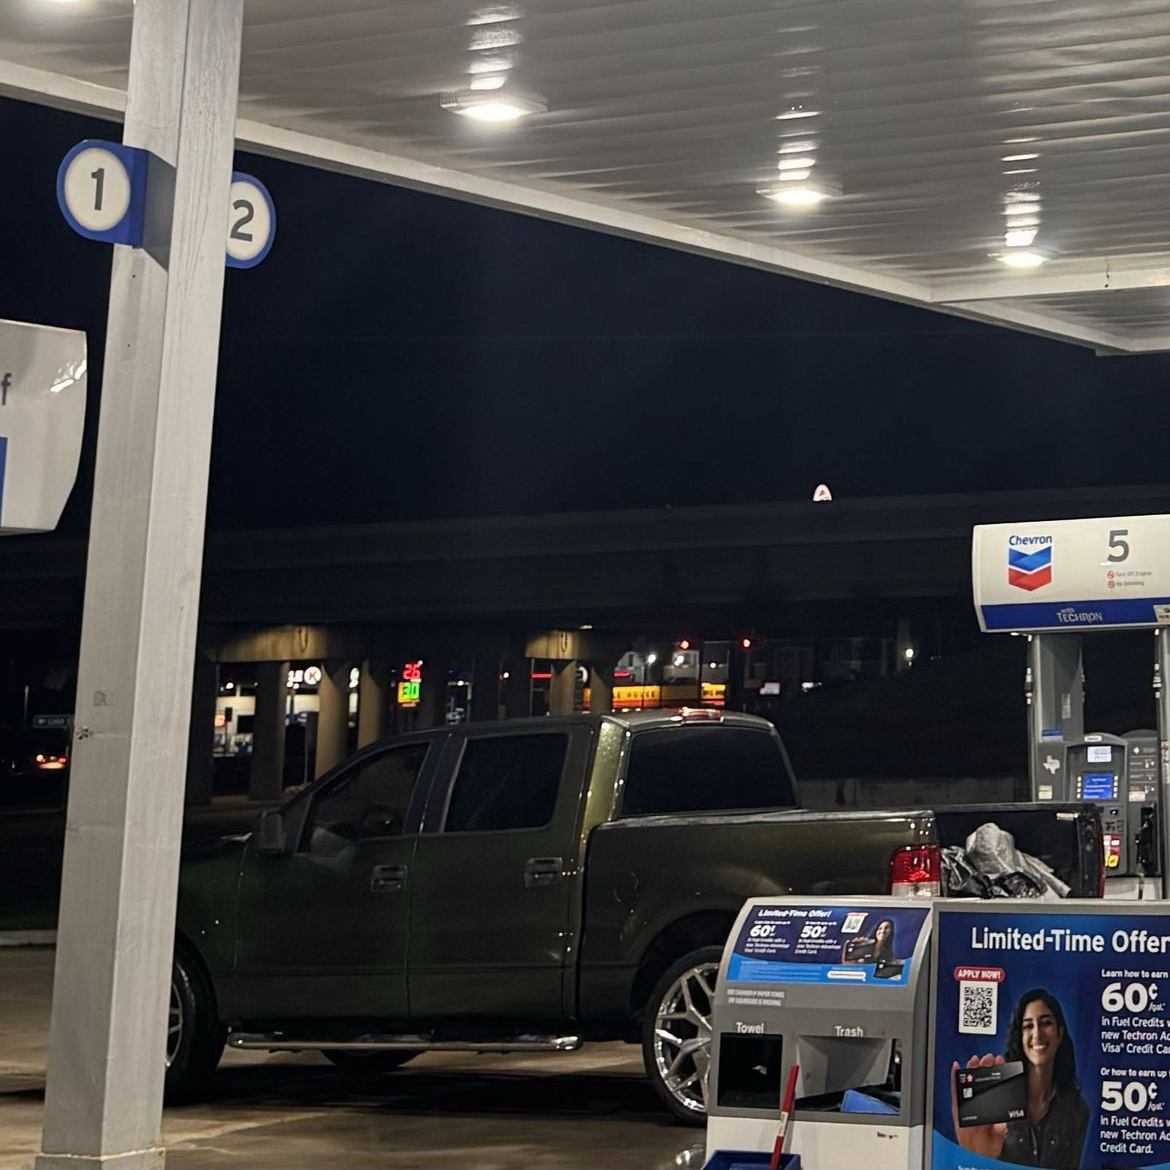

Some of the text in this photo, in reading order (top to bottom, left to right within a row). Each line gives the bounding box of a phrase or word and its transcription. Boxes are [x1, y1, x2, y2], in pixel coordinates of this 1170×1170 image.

[91, 167, 105, 211] 1
[230, 199, 255, 242] 2
[1008, 533, 1053, 546] Chevron
[1106, 529, 1130, 563] 5
[1056, 612, 1103, 623] TECHRON
[971, 926, 1105, 952] Limited-Time
[958, 969, 1001, 980] APPLY NOW!
[1101, 969, 1122, 978] Learn
[1124, 969, 1140, 978] how
[1141, 970, 1150, 979] to
[1151, 971, 1168, 979] earn
[736, 1021, 764, 1034] Towel
[1101, 1016, 1110, 1027] in
[1111, 1016, 1130, 1027] Fuel
[1132, 1017, 1165, 1028] Credits
[835, 1025, 864, 1038] Trash
[1101, 1031, 1119, 1040] new
[1122, 1030, 1158, 1041] Techron
[1126, 1043, 1154, 1054] Credit
[1100, 1067, 1109, 1076] Or
[1111, 1068, 1127, 1077] how
[1128, 1069, 1137, 1077] to
[1157, 1070, 1167, 1079] up
[1008, 1109, 1024, 1118] VISA
[1100, 1115, 1109, 1126] in
[1110, 1115, 1130, 1126] Fuel
[1131, 1117, 1164, 1128] Credits
[1100, 1130, 1119, 1139] new
[1121, 1129, 1157, 1140] Techron
[1100, 1142, 1154, 1154] Credit Card.
